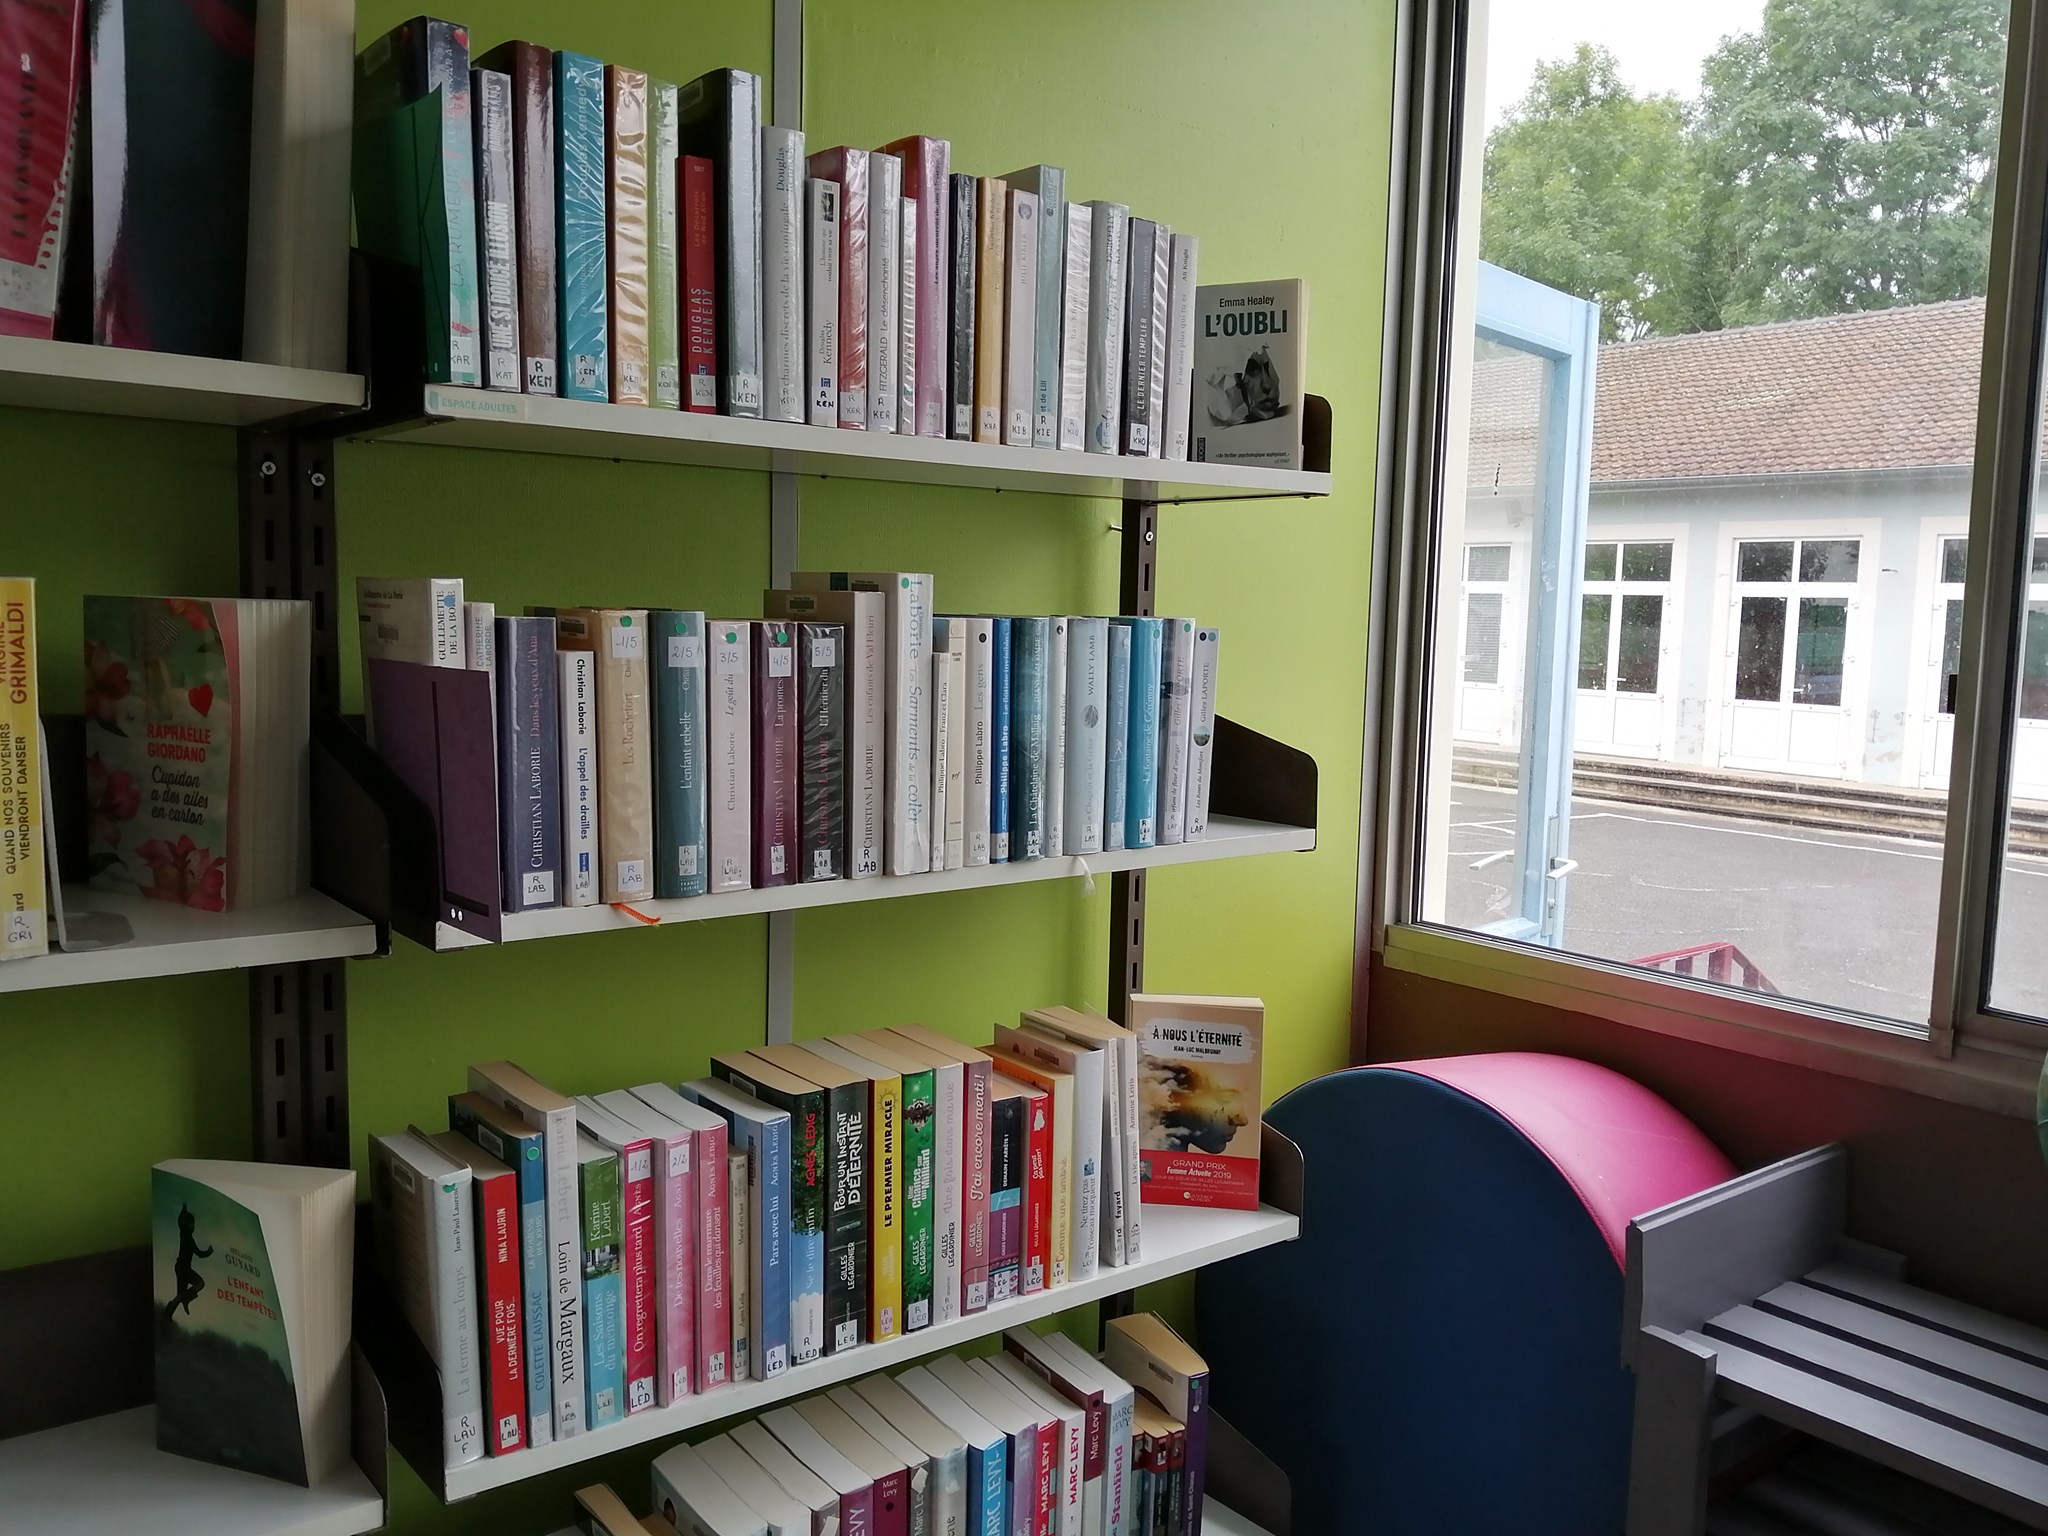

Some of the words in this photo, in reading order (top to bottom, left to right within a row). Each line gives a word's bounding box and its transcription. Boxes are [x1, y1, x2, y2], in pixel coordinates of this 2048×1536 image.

[576, 84, 589, 139] Kennedy
[576, 143, 590, 199] Douglas
[775, 147, 786, 191] Douglas
[488, 201, 509, 259] ILLUSION
[781, 202, 791, 253] conjugale
[780, 255, 790, 271] vie
[780, 273, 790, 284] la
[489, 263, 511, 303] DOUCE
[780, 285, 790, 297] de
[879, 257, 889, 317] désenchanté
[491, 308, 511, 318] SI
[1219, 298, 1245, 309] Emma
[1247, 295, 1275, 307] Healey
[491, 321, 513, 348] UNE
[690, 287, 703, 353] DOUGLAS
[701, 288, 713, 354] KENNEDY
[780, 299, 790, 340] discrets
[880, 319, 889, 331] Le
[1178, 316, 1187, 331] qui
[1204, 309, 1288, 338] L'OUBLI
[823, 319, 834, 365] Kennedy
[1138, 317, 1148, 358] TEMPLIER
[1178, 333, 1187, 348] plus
[781, 343, 790, 387] charmes
[880, 336, 888, 392] FITZGERALD
[1177, 349, 1185, 364] sais
[1177, 366, 1185, 376] ne
[529, 374, 553, 388] KEN
[1137, 362, 1146, 396] DERNIER
[1176, 378, 1185, 386] Je
[441, 398, 477, 411] ESPACE
[478, 401, 518, 415] ADULTES
[1137, 400, 1145, 409] LE
[907, 579, 923, 660] Laborie
[6, 601, 29, 705] GRIMALDI
[475, 617, 484, 667] CATHERINE
[484, 626, 492, 667] LABORDE
[1088, 635, 1096, 662] LAMB
[577, 659, 586, 698] Christian
[1087, 664, 1096, 696] WALLY
[1200, 662, 1210, 700] LAPORTE
[578, 702, 586, 735] Laborie
[621, 692, 634, 744] Rochefort
[908, 685, 922, 761] Sarments
[939, 713, 947, 733] Franz
[940, 702, 947, 711] et
[1199, 701, 1208, 723] Gilles
[681, 712, 692, 745] rebelle
[1031, 713, 1041, 747] Mallaig
[1144, 725, 1152, 735] de
[0, 722, 13, 794] SOUVENIRS
[14, 736, 27, 785] DANSER
[147, 743, 206, 763] GIORDANO
[622, 746, 634, 766] Les
[728, 731, 736, 765] Laborie
[773, 736, 784, 783] LABORIE
[1031, 750, 1039, 761] de
[1143, 736, 1153, 770] fontaine
[152, 765, 200, 788] Cupidon
[529, 747, 543, 800] LABORIE
[579, 748, 588, 782] L'appel
[680, 747, 692, 789] L'enfant
[864, 744, 875, 791] LABORIE
[938, 763, 946, 793] Philippe
[151, 789, 160, 801] a
[162, 788, 180, 804] des
[183, 790, 208, 809] ailes
[580, 784, 588, 801] des
[727, 768, 736, 811] Christian
[1030, 764, 1039, 811] Châtelaine
[2, 799, 15, 826] NOS
[16, 787, 31, 861] VIENDRONT
[152, 806, 165, 819] en
[168, 808, 205, 825] carton
[580, 804, 588, 840] drailles
[773, 785, 784, 846] CHRISTIAN
[863, 793, 875, 849] CHRISTIAN
[1030, 813, 1038, 825] La
[3, 829, 18, 875] QUAND
[530, 803, 544, 868] CHRISTIAN
[622, 873, 643, 885] LAB
[857, 861, 877, 873] LAB
[1153, 1025, 1160, 1040] À
[1161, 1028, 1188, 1042] NOUS
[1190, 1029, 1243, 1047] L'ÉTERNITÉ
[806, 1112, 816, 1146] LEDIG
[884, 1099, 893, 1154] MIRACLE
[1128, 1100, 1136, 1129] Antoine
[769, 1125, 779, 1154] LEDIG
[836, 1112, 848, 1158] INSTANT
[973, 1117, 984, 1170] encore
[769, 1156, 780, 1186] AGNÈS
[805, 1149, 816, 1186] AGNÈS
[836, 1160, 848, 1179] UN
[847, 1112, 862, 1204] D'ÉTERNITÉ
[1167, 1167, 1188, 1175] Femme
[1213, 1170, 1232, 1179] 2019
[1172, 1159, 1205, 1169] GRAND
[1206, 1161, 1226, 1170] PRIX
[833, 1180, 849, 1212] POUR
[884, 1157, 893, 1211] PREMIER
[970, 1172, 984, 1200] J'ai
[590, 1201, 601, 1241] Karine
[600, 1200, 612, 1239] Lebert
[884, 1212, 893, 1228] LE
[1114, 1191, 1123, 1219] fayard
[496, 1208, 507, 1241] LAURIN
[497, 1243, 508, 1263] NINA
[558, 1240, 571, 1272] Loin
[912, 1240, 920, 1265] GILLES
[919, 1227, 927, 1274] LEGARDINIER
[941, 1234, 949, 1259] GILLES
[947, 1221, 956, 1268] LEGARDINIER
[225, 1254, 261, 1278] GUYARD
[840, 1254, 849, 1281] GILLES
[847, 1241, 857, 1290] LEGARDINIER
[217, 1288, 235, 1303] DES
[227, 1276, 264, 1299] L'ENFANT
[559, 1277, 571, 1294] de
[494, 1300, 504, 1324] POUR
[531, 1290, 544, 1342] LAUSSAC
[592, 1293, 605, 1339] Saisons
[604, 1289, 619, 1353] mensonge
[495, 1326, 505, 1344] VUE
[505, 1326, 517, 1366] DERNIÈRE
[557, 1296, 578, 1384] Margaux
[532, 1344, 546, 1391] COLETTE
[594, 1342, 605, 1367] Les
[605, 1355, 617, 1371] du
[509, 1368, 518, 1381] LA
[636, 1380, 646, 1392] R
[631, 1394, 651, 1407] LED
[461, 1416, 469, 1428] R
[1093, 1411, 1102, 1437] Levy
[1042, 1442, 1050, 1475] LEVY
[1070, 1427, 1080, 1467] LEVY
[1090, 1438, 1098, 1460] Marc
[882, 1478, 898, 1489] Marc
[883, 1488, 897, 1498] Levy
[1041, 1477, 1050, 1513] MARC
[1069, 1468, 1079, 1506] MARC
[1112, 1445, 1123, 1525] Stanfield
